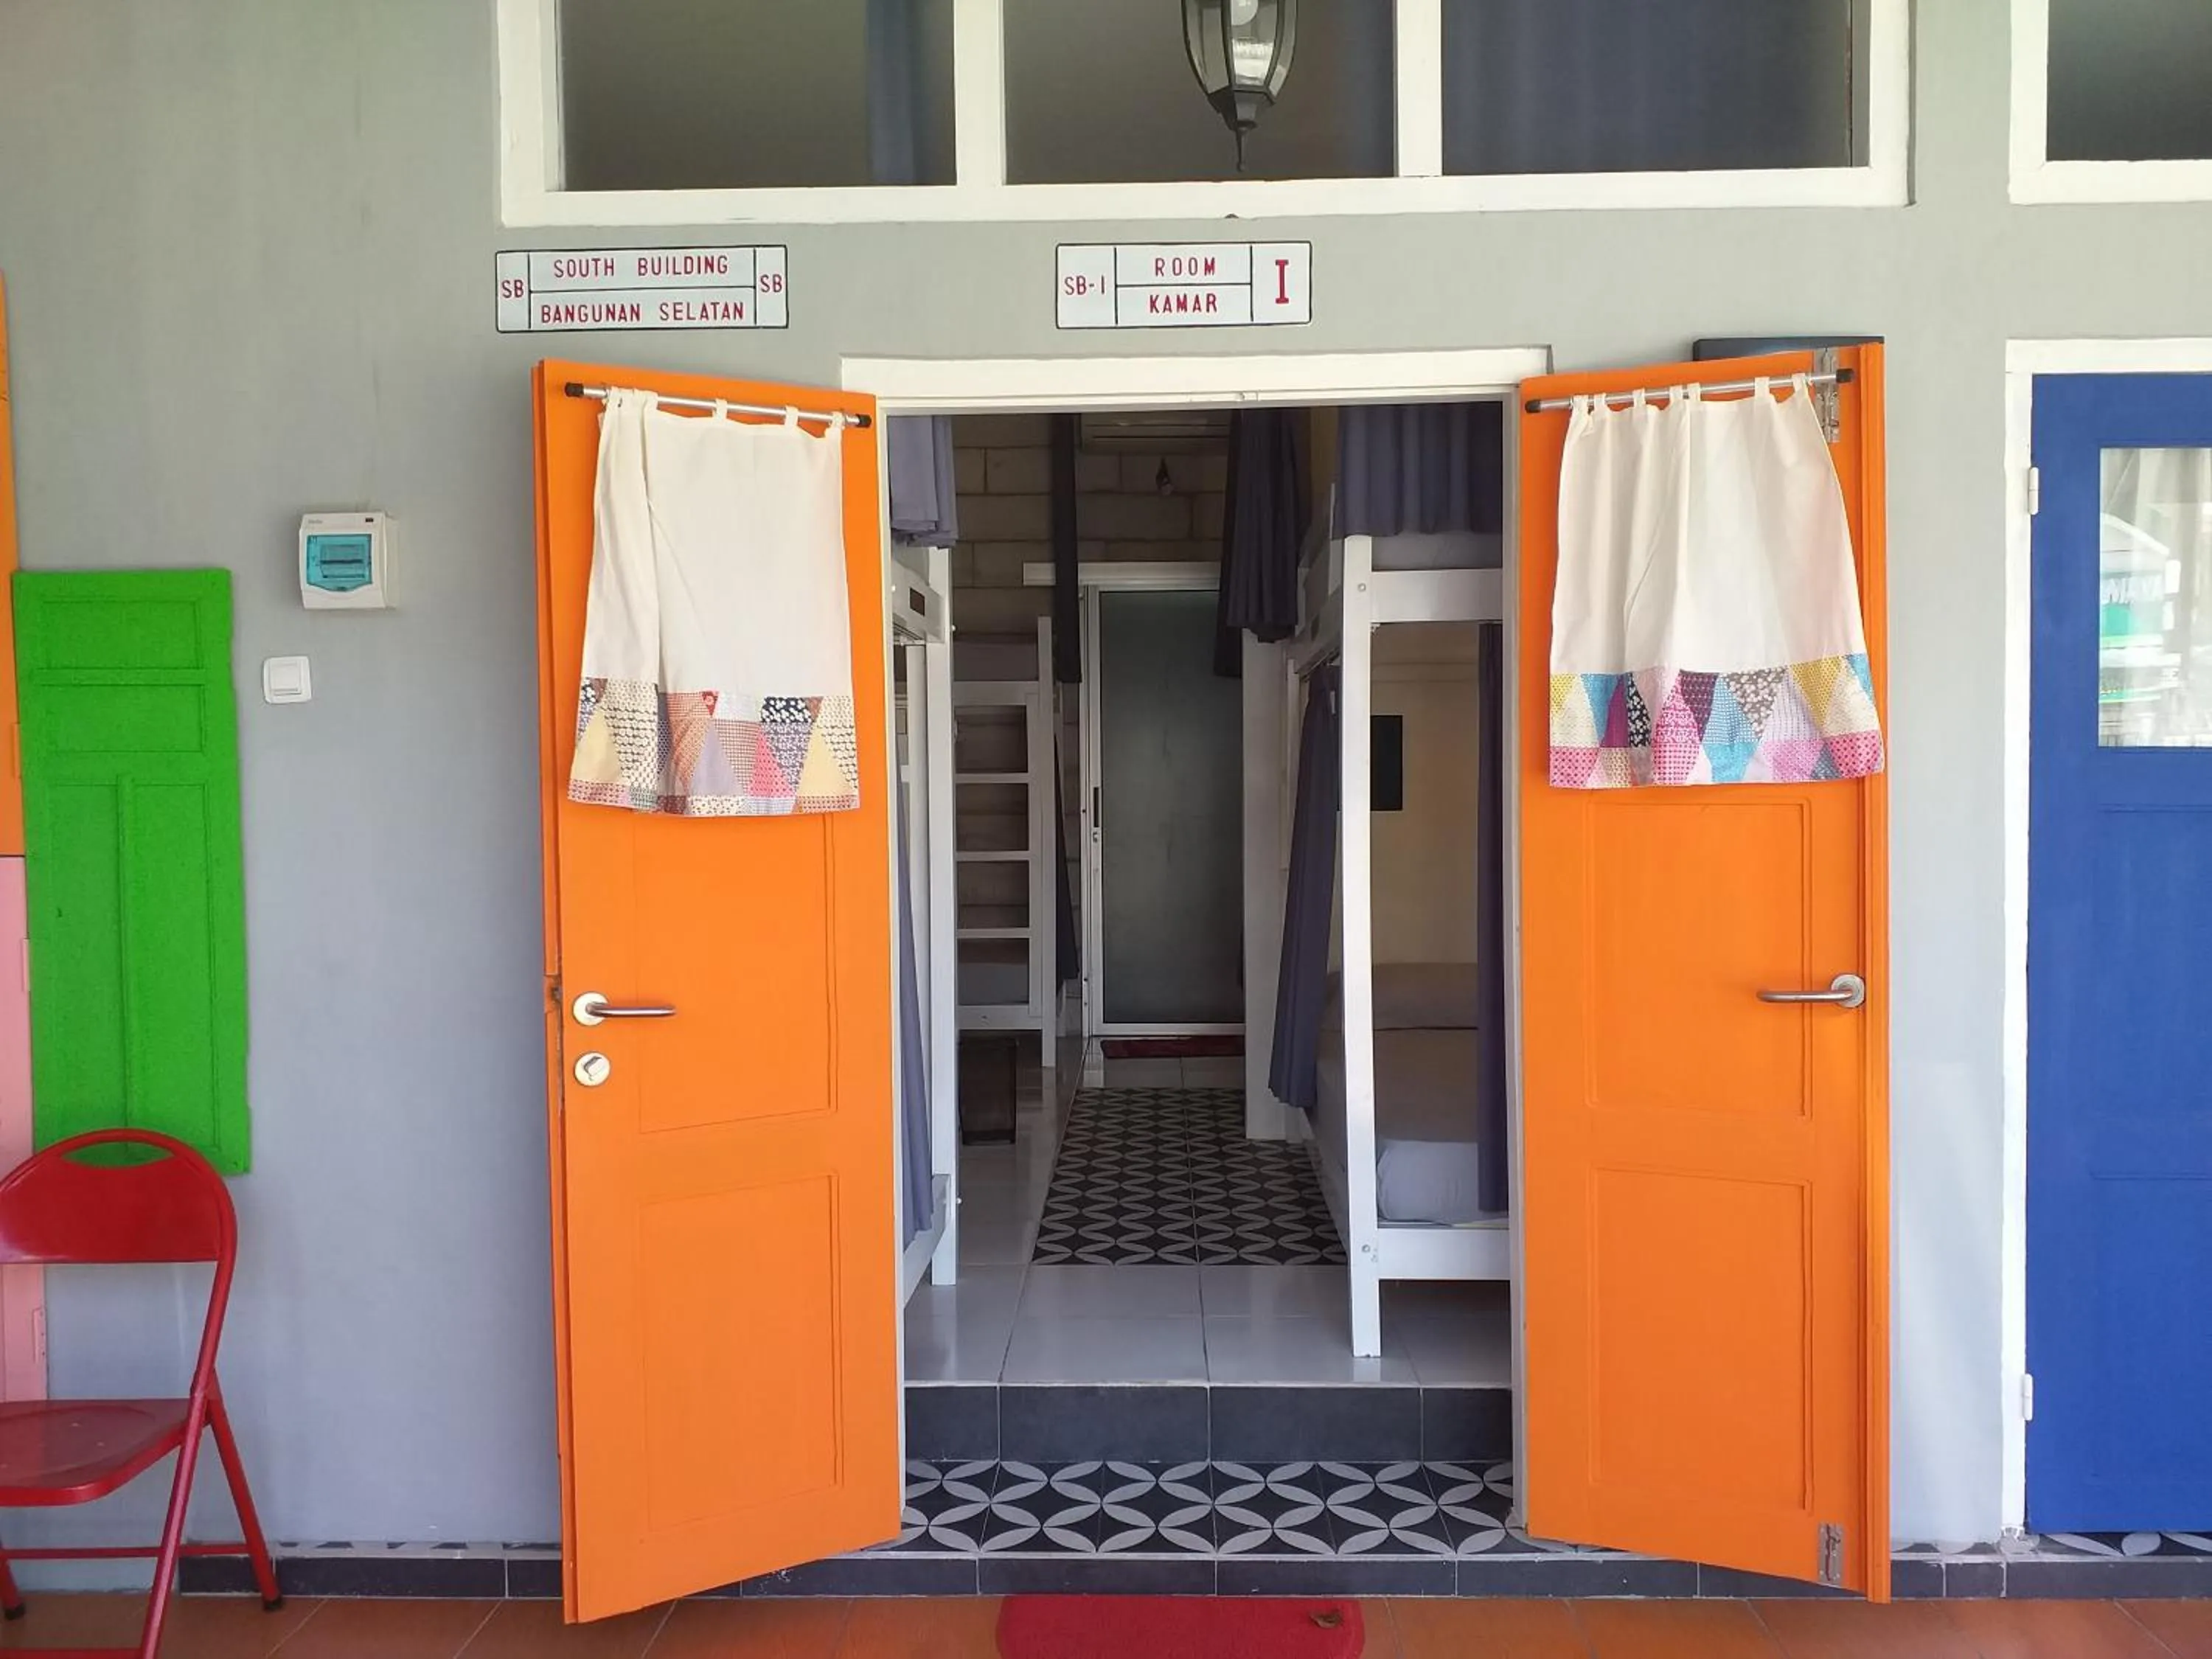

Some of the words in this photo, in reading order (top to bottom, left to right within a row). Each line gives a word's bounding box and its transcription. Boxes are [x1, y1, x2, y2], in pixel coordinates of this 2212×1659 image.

[554, 258, 614, 278] SOUTH
[638, 255, 728, 276] BUILDING
[1155, 257, 1216, 276] ROOM
[501, 279, 524, 298] SB
[760, 274, 782, 293] SB
[541, 303, 640, 323] BANGUNAN
[660, 302, 744, 321] SELATAN
[1150, 293, 1217, 313] KAMAR
